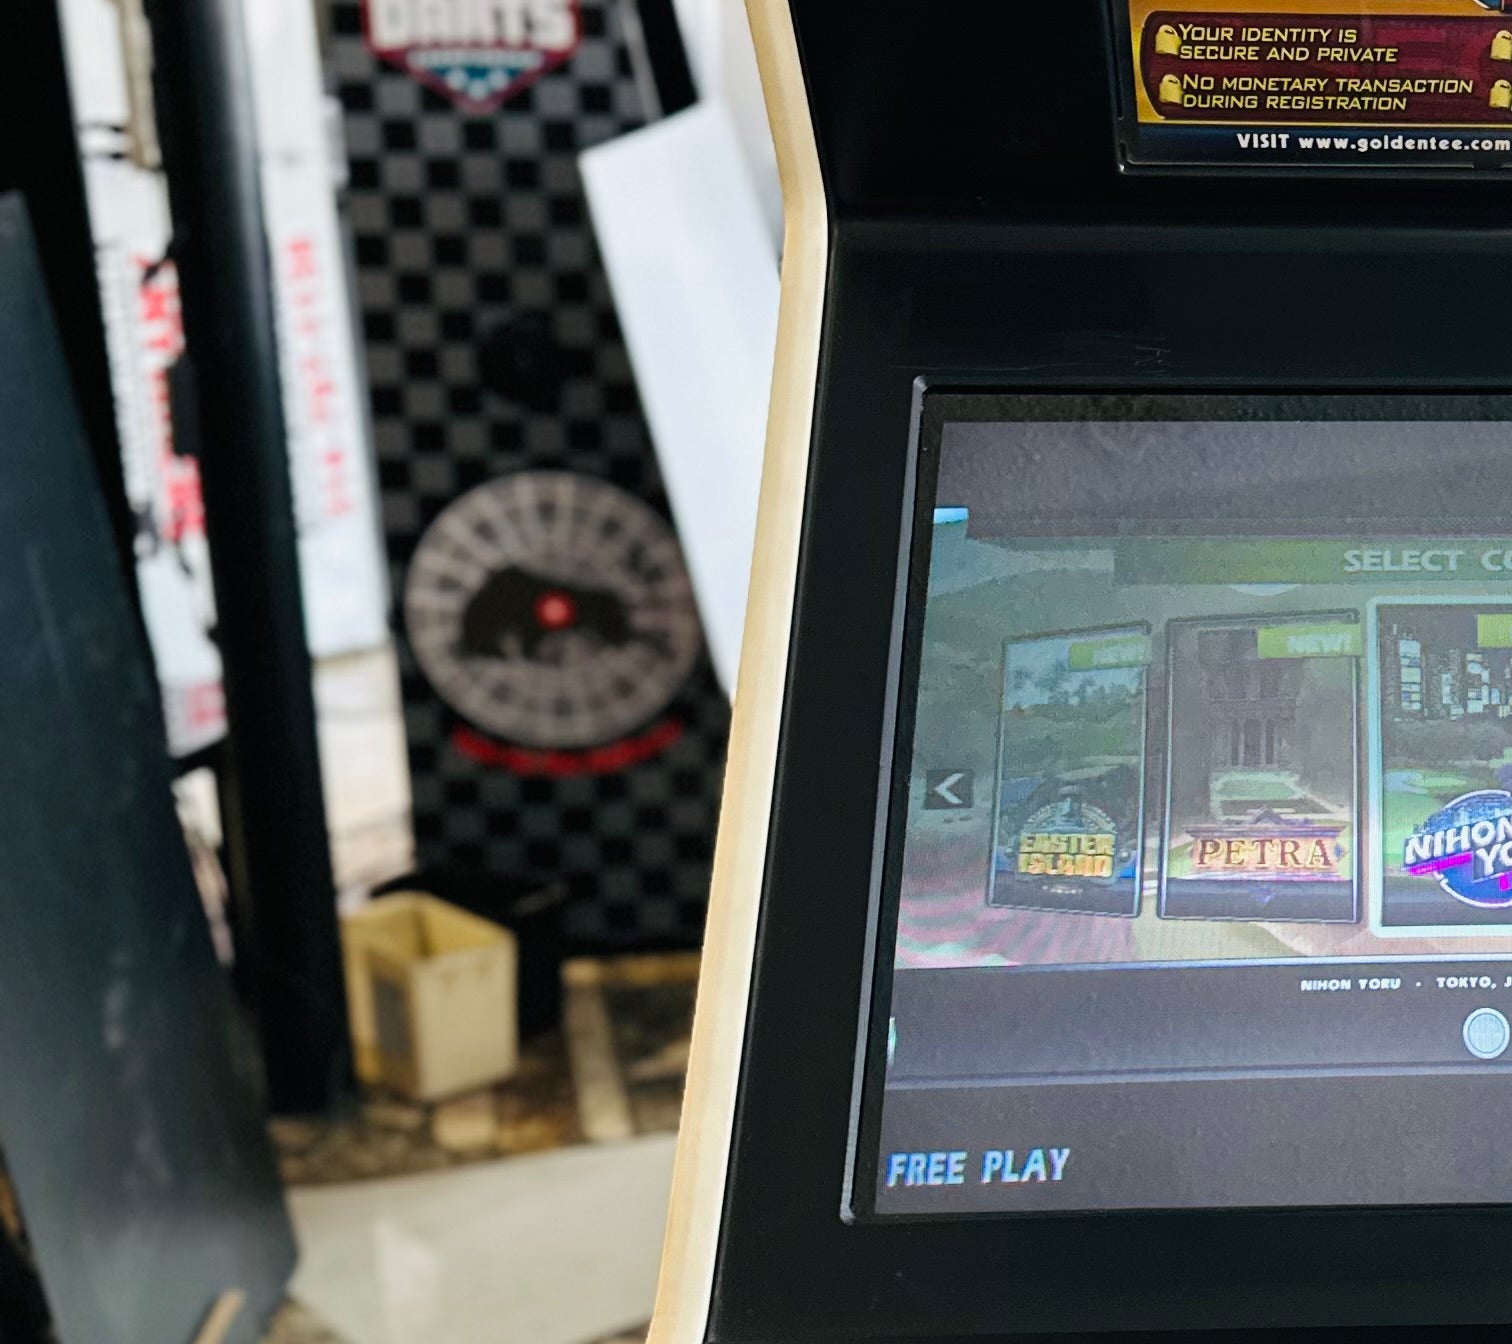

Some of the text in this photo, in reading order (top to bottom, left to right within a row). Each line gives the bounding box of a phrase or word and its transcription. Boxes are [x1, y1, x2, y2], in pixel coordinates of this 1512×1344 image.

[1177, 23, 1358, 44] YOUR IDENTITY IS
[1180, 45, 1399, 63] SECURE AND PRIVATE
[1182, 74, 1474, 94] NO MONETARY TRANSACTION
[1183, 94, 1407, 111] DURING REGISTRATION
[1236, 133, 1290, 149] VISIT
[1298, 135, 1511, 153] www.goldentee.com
[1343, 548, 1463, 572] SELECT
[1196, 838, 1334, 867] PETRA
[1301, 979, 1352, 992] NIHON
[1359, 978, 1401, 990] YORU
[886, 1147, 1070, 1186] FREE PLAY
